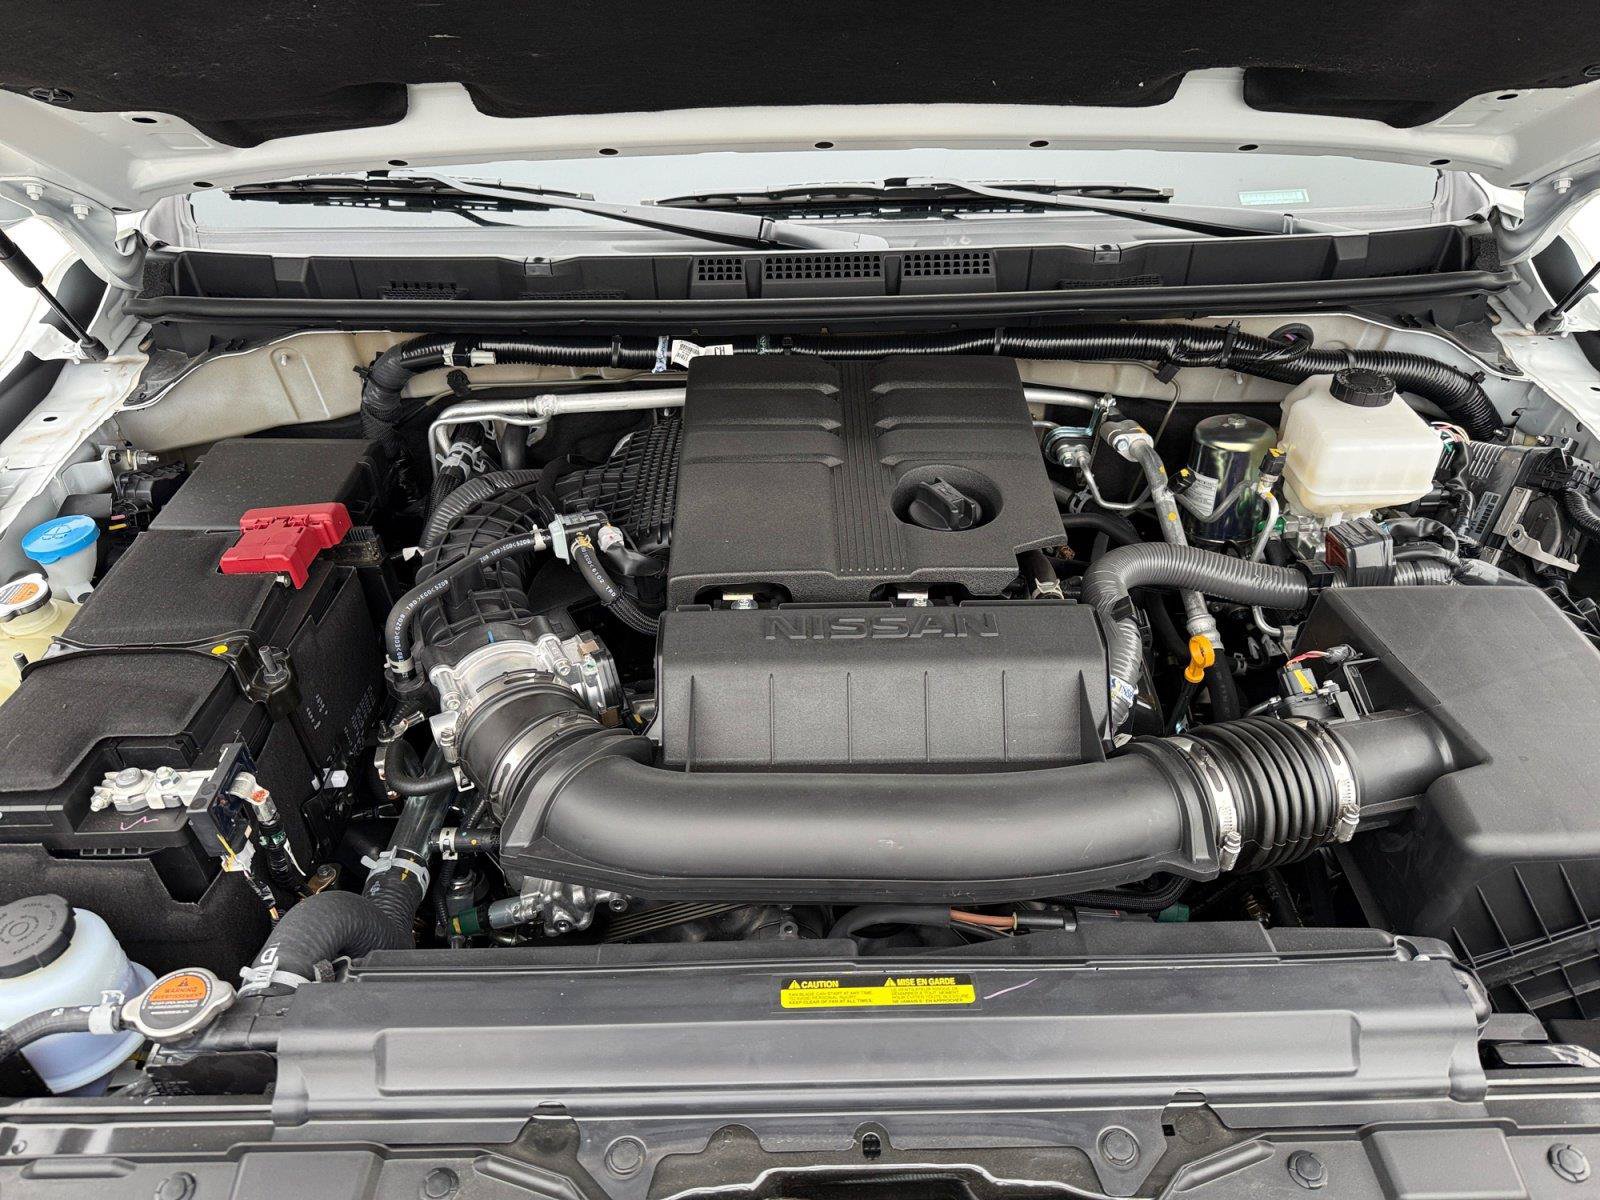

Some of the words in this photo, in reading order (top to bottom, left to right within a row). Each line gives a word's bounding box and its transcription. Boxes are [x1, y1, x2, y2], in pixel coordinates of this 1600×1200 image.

[763, 612, 999, 640] NISSAN
[801, 980, 839, 989] CAUTION
[896, 979, 916, 987] MISE
[917, 978, 929, 986] EN
[929, 977, 956, 986] GARDE
